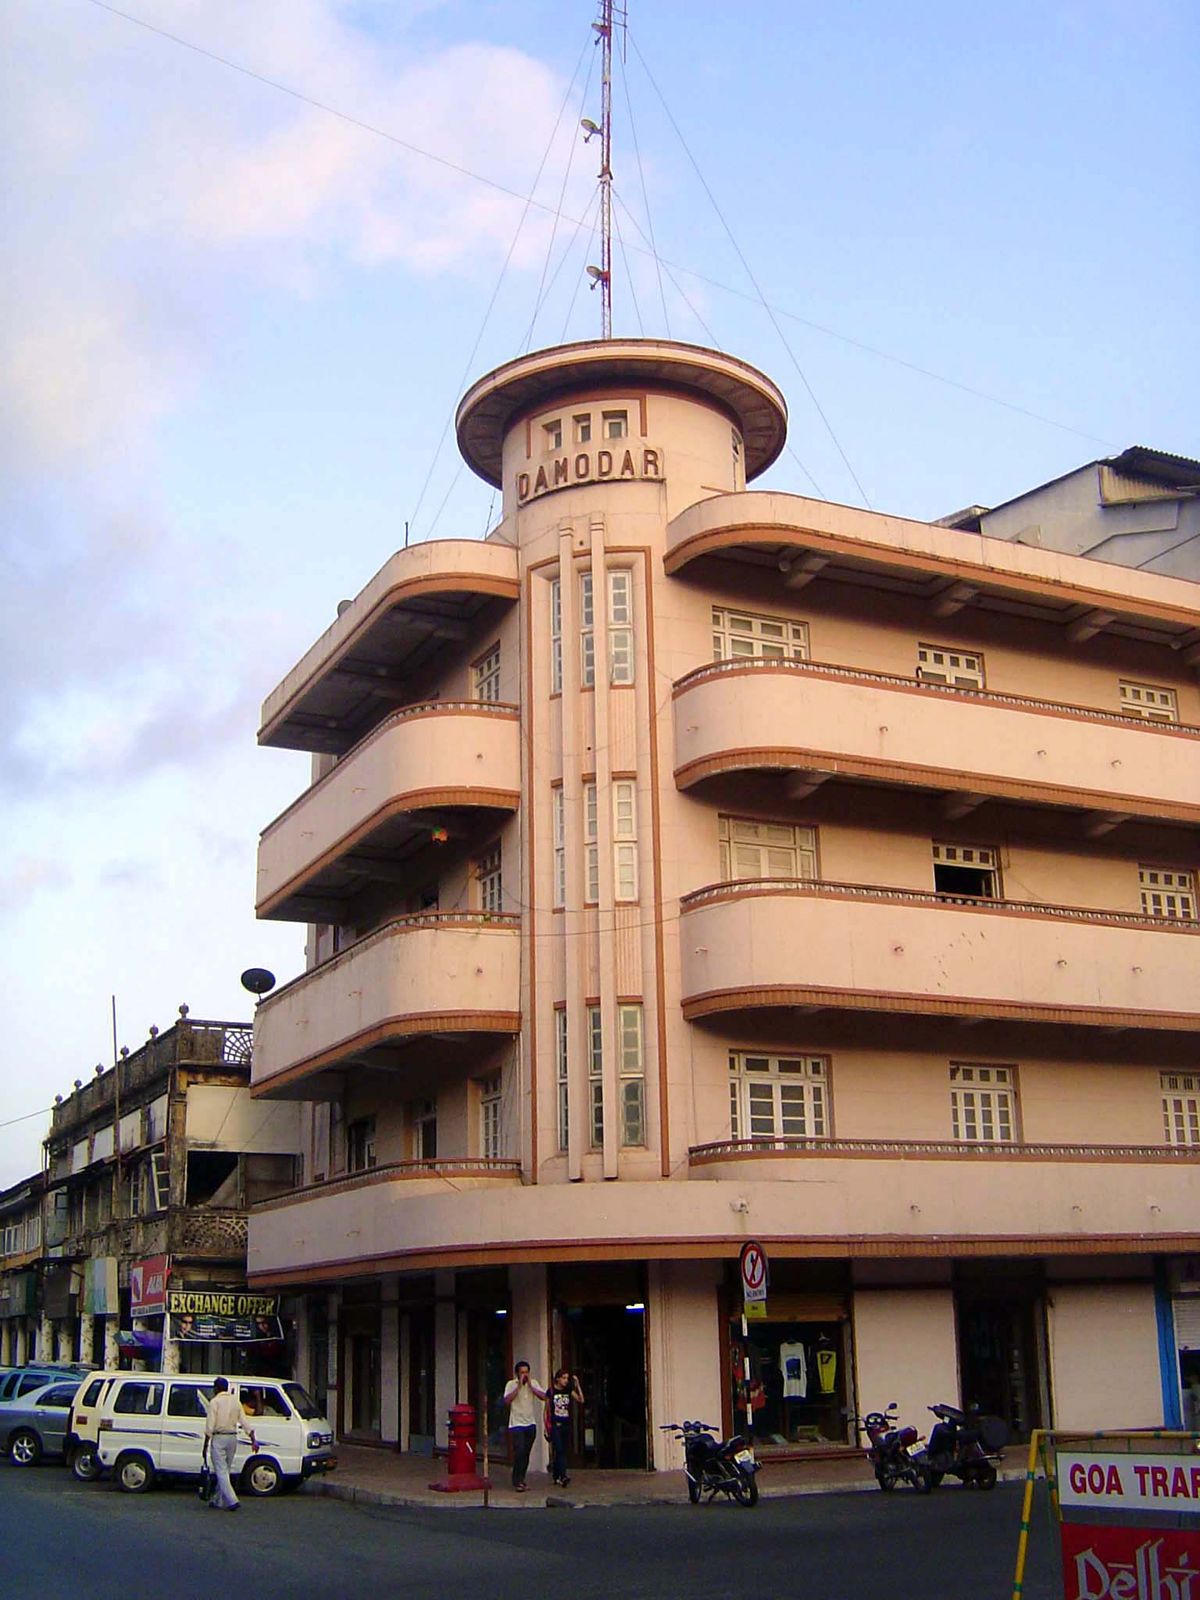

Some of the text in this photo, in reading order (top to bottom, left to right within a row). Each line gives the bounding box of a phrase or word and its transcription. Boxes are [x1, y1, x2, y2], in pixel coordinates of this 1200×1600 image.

[518, 449, 660, 501] DAMODAR
[170, 1293, 235, 1315] EXCHANGE
[237, 1296, 275, 1316] OFFER
[1069, 1463, 1124, 1496] GOA
[1073, 1537, 1200, 1600] Delhi
